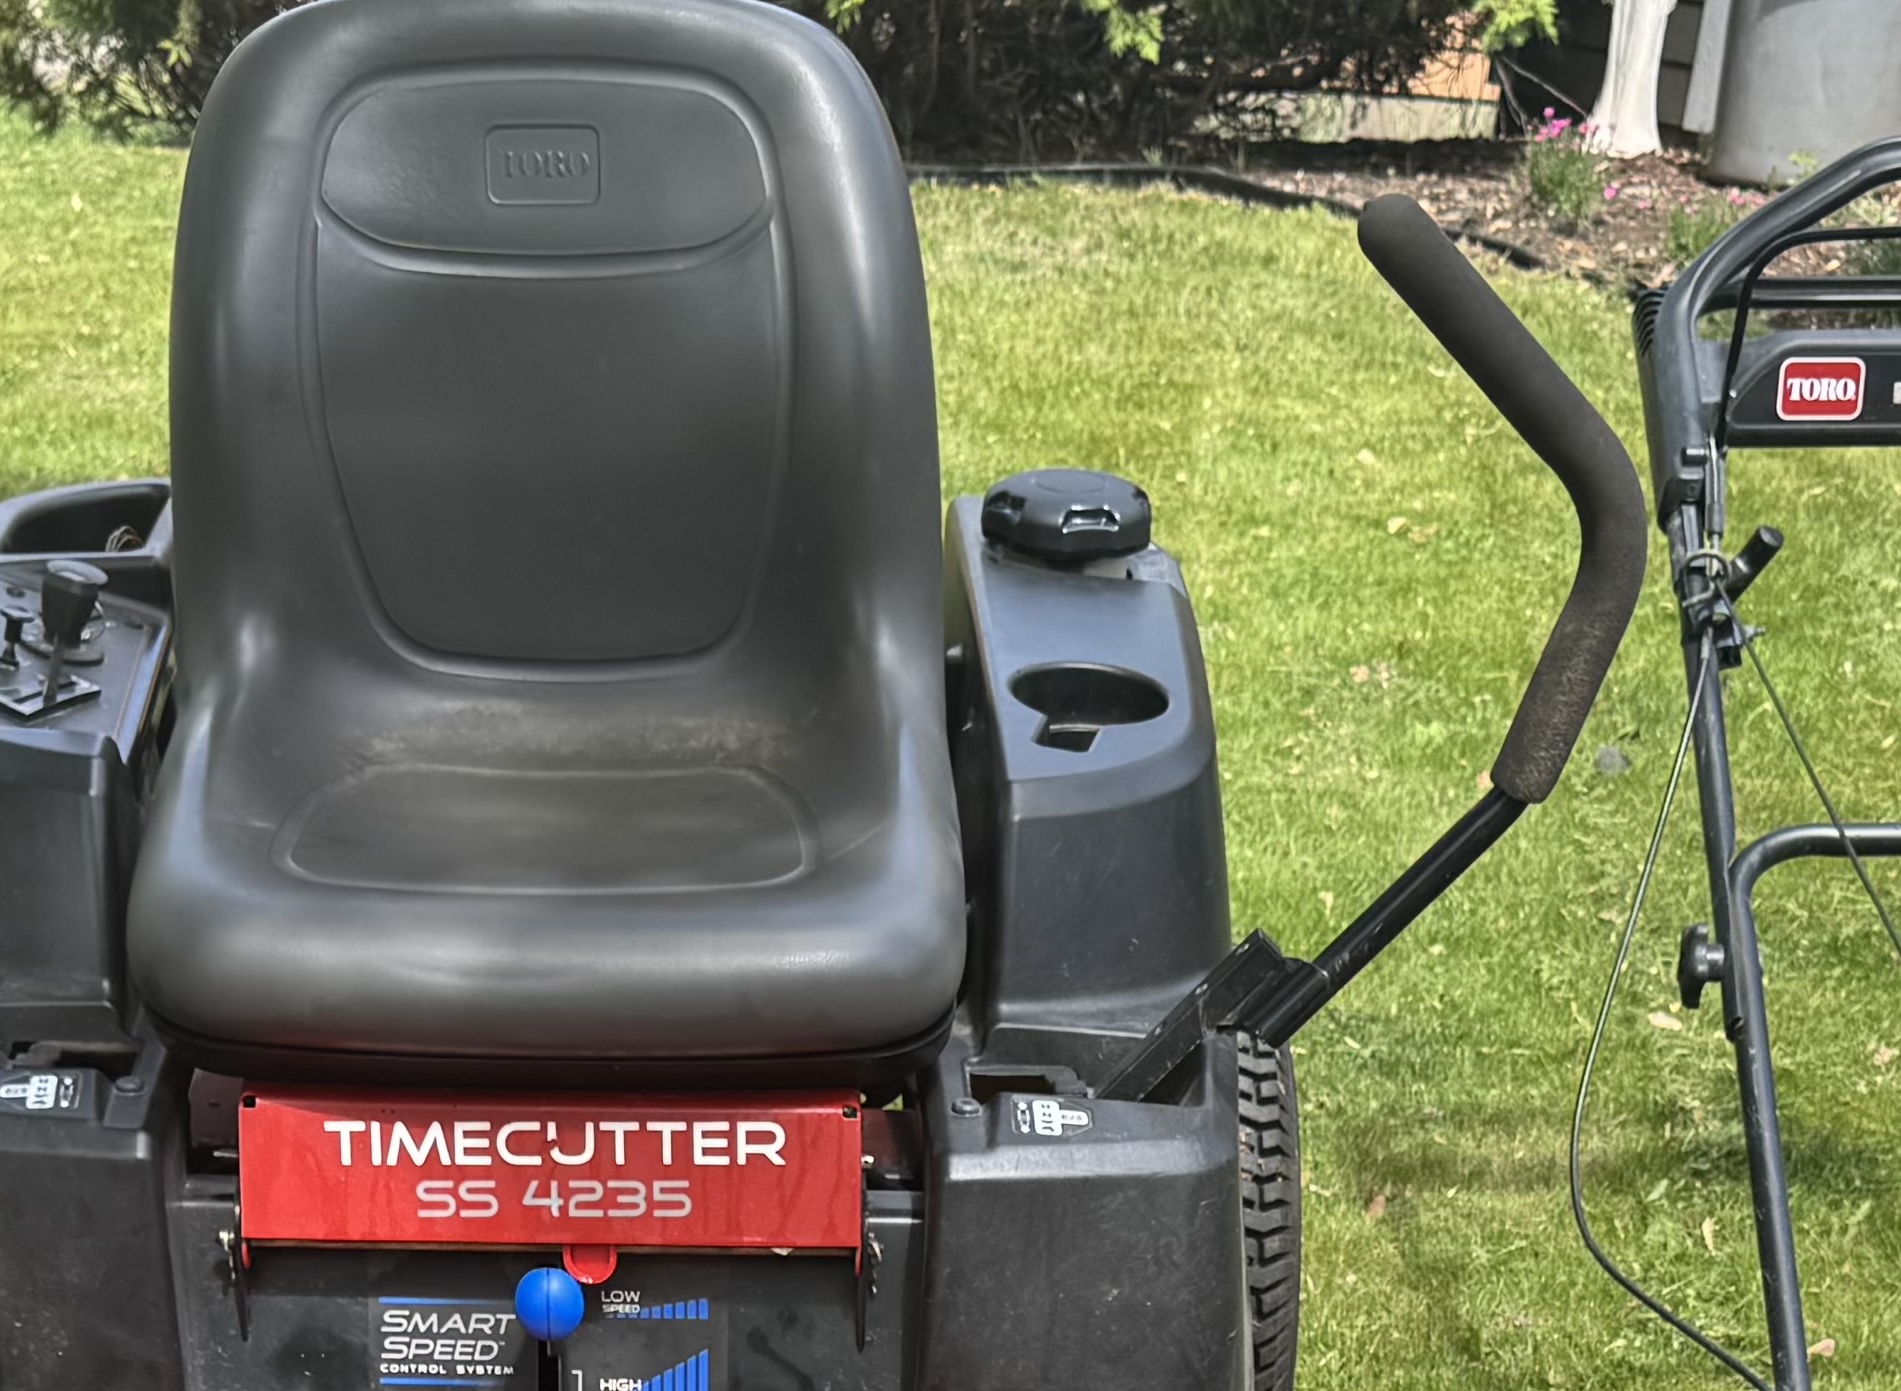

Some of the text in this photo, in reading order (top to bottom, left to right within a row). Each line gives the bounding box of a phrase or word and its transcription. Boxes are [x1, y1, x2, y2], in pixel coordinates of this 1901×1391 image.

[503, 150, 591, 179] TORO
[323, 1120, 787, 1167] TIMECUTTER
[416, 1179, 693, 1218] SS 4235
[600, 1290, 641, 1303] LOW
[380, 1309, 516, 1335] SMART
[379, 1363, 515, 1376] CONTROL SYSTEM
[599, 1377, 643, 1391] HIGH
